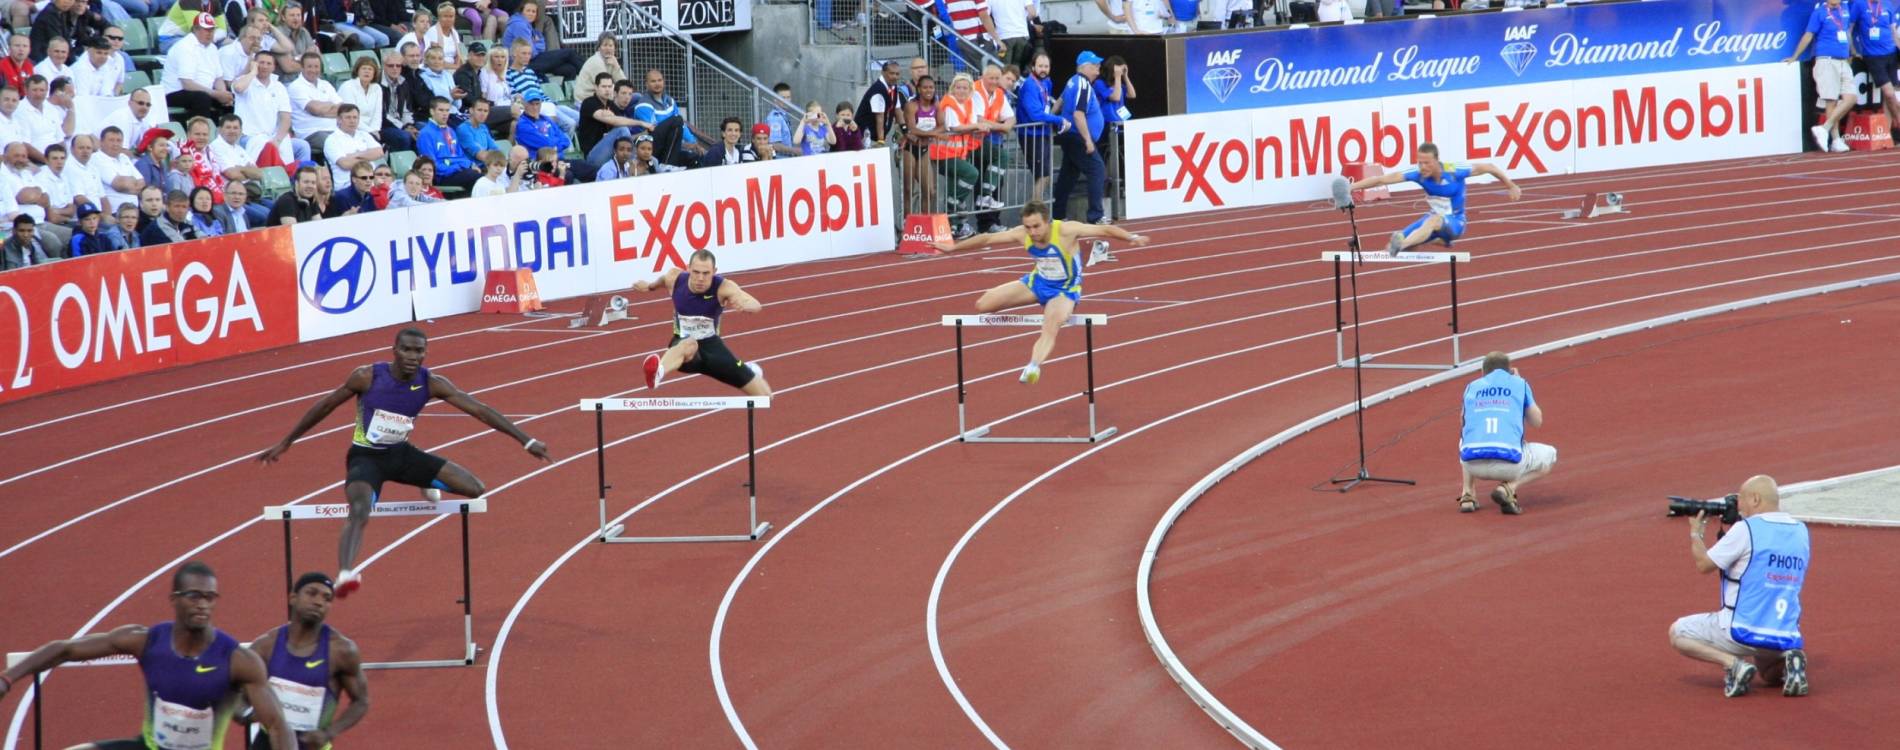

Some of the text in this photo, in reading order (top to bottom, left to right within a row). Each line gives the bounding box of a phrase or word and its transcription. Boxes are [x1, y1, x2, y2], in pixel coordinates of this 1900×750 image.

[562, 10, 585, 35] NE
[605, 5, 660, 32] ZONE
[680, 0, 732, 26] ZONE
[1504, 24, 1538, 41] IAAF
[1545, 20, 1787, 68] Diamond League
[1207, 49, 1242, 66] IAAF
[1250, 45, 1480, 94] Diamond League
[1464, 77, 1765, 174] ExxonMobil
[1142, 106, 1433, 206] ExxonMobil
[609, 163, 879, 273] ExxonMobil
[903, 234, 932, 242] OMEGA
[390, 213, 589, 295] HYUNDAI
[51, 250, 264, 369] OMEGA
[484, 294, 517, 303] OMEGA
[623, 399, 675, 409] ExxonMobil
[1475, 387, 1512, 398] PHOTO
[1485, 417, 1499, 434] 11
[1768, 554, 1804, 570] PHOTO
[1776, 598, 1788, 620] 9
